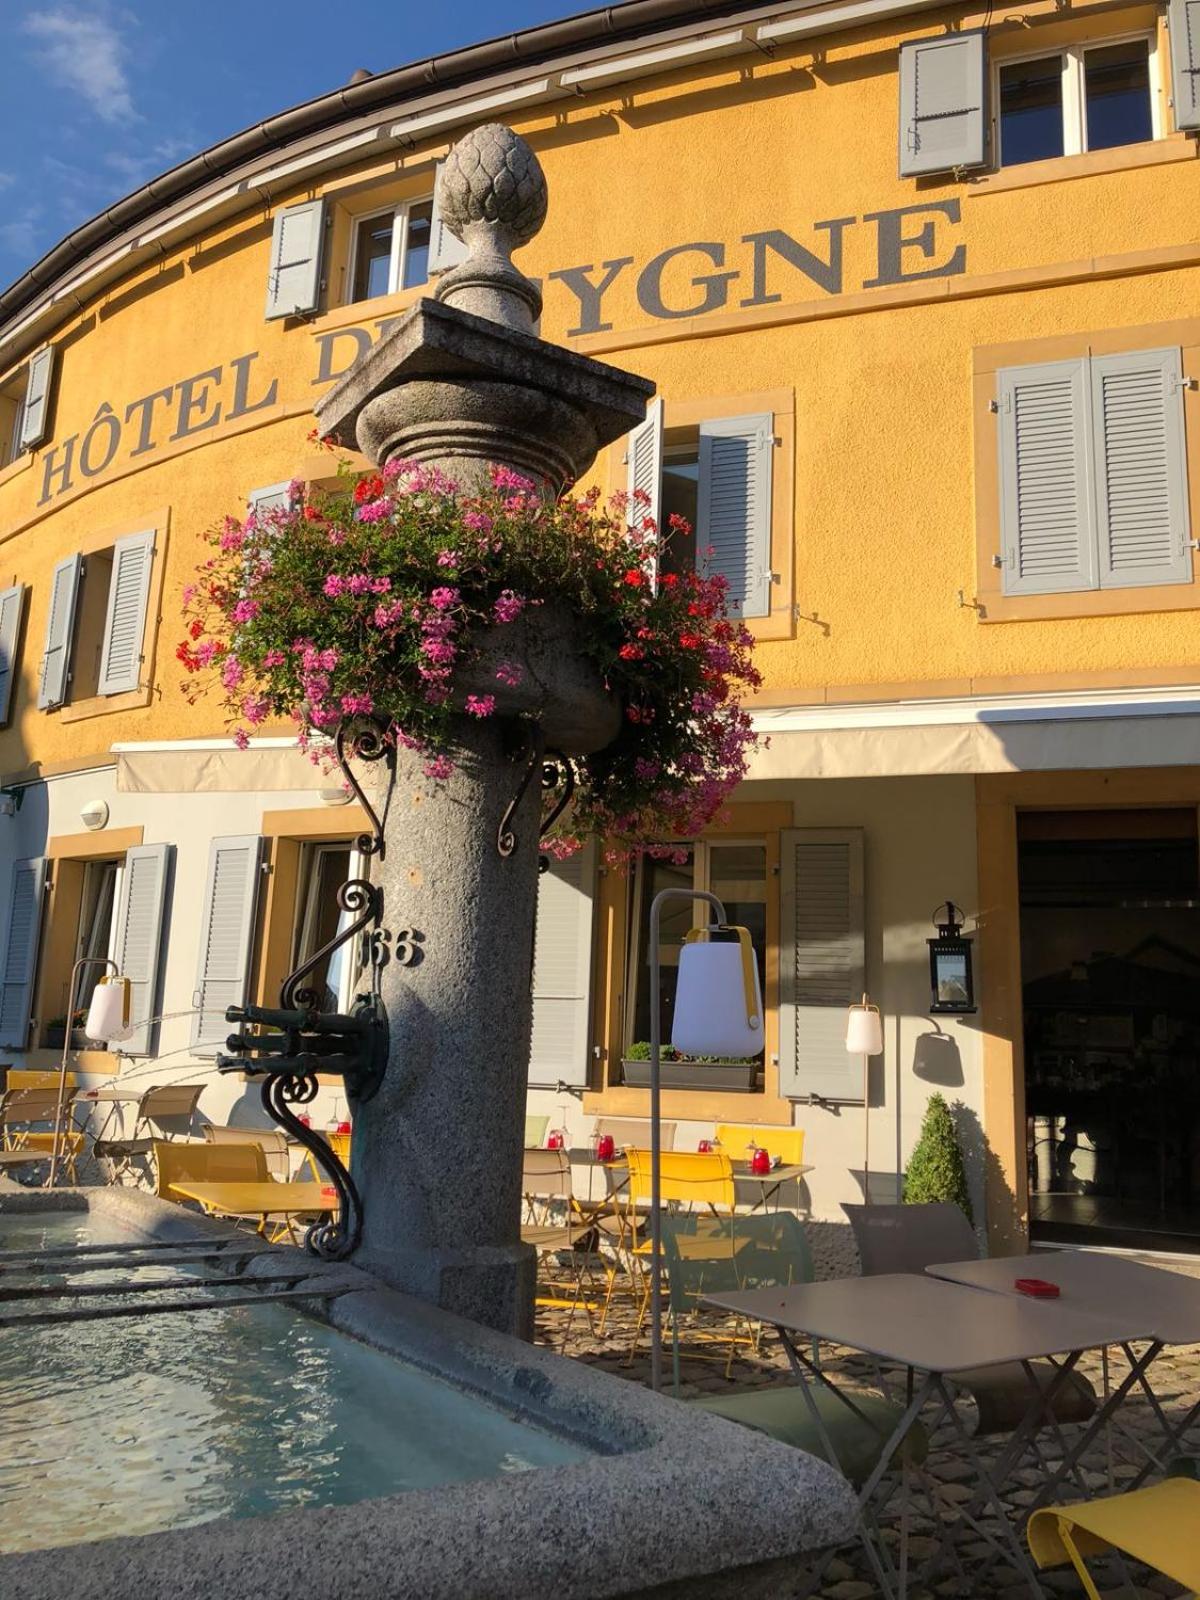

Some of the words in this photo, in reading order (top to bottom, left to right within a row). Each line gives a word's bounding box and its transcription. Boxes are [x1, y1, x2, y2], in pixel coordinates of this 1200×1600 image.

[37, 351, 278, 507] HÔTEL
[311, 315, 402, 386] D
[527, 197, 967, 338] YGNE
